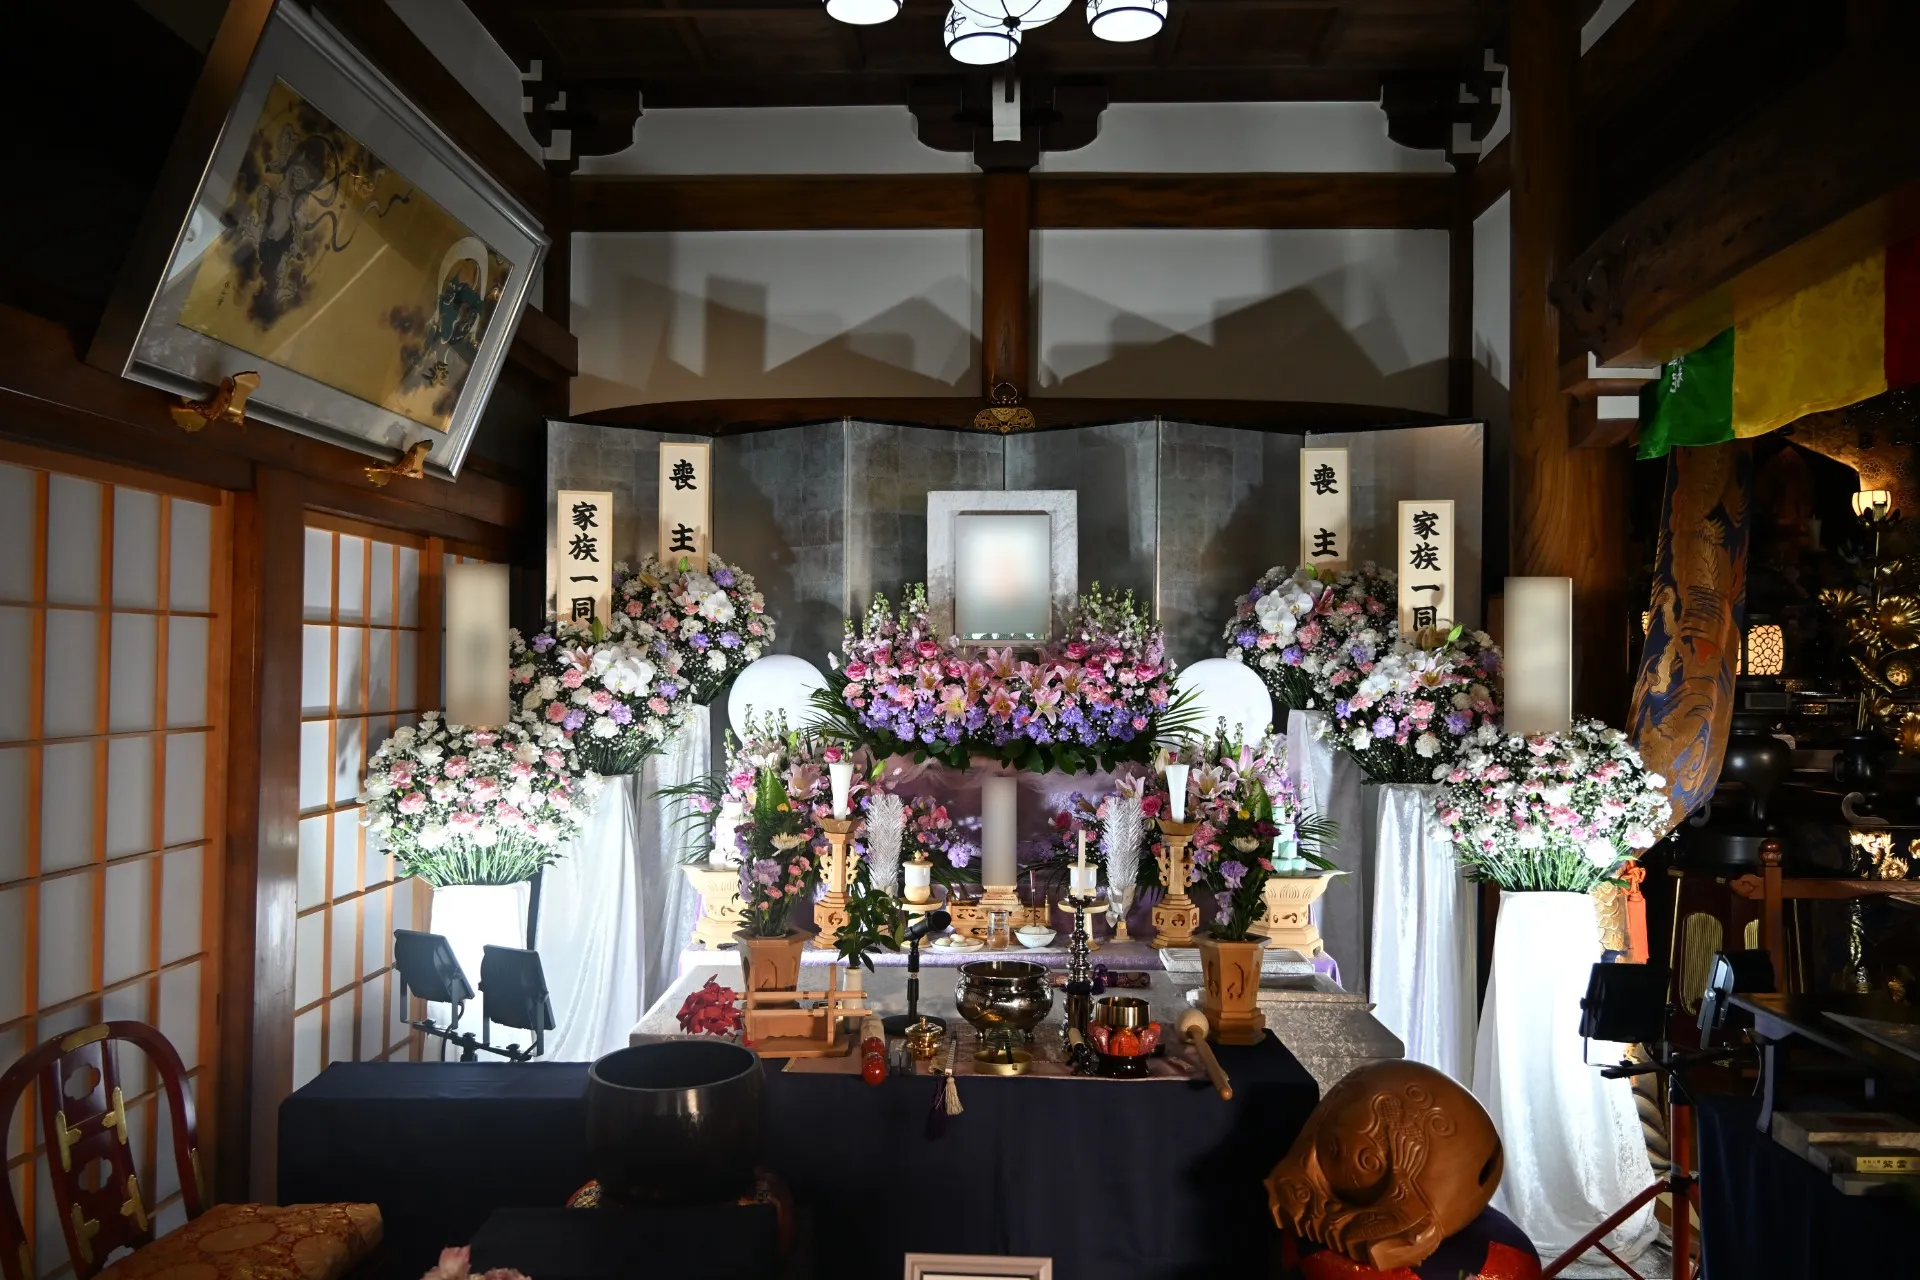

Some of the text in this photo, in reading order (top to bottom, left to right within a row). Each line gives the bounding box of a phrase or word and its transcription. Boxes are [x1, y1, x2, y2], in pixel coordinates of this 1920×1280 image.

[668, 458, 698, 554] 喪主
[1309, 463, 1340, 559] 喪主
[568, 500, 600, 625] 家族一同
[1409, 509, 1443, 633] 家族一同
